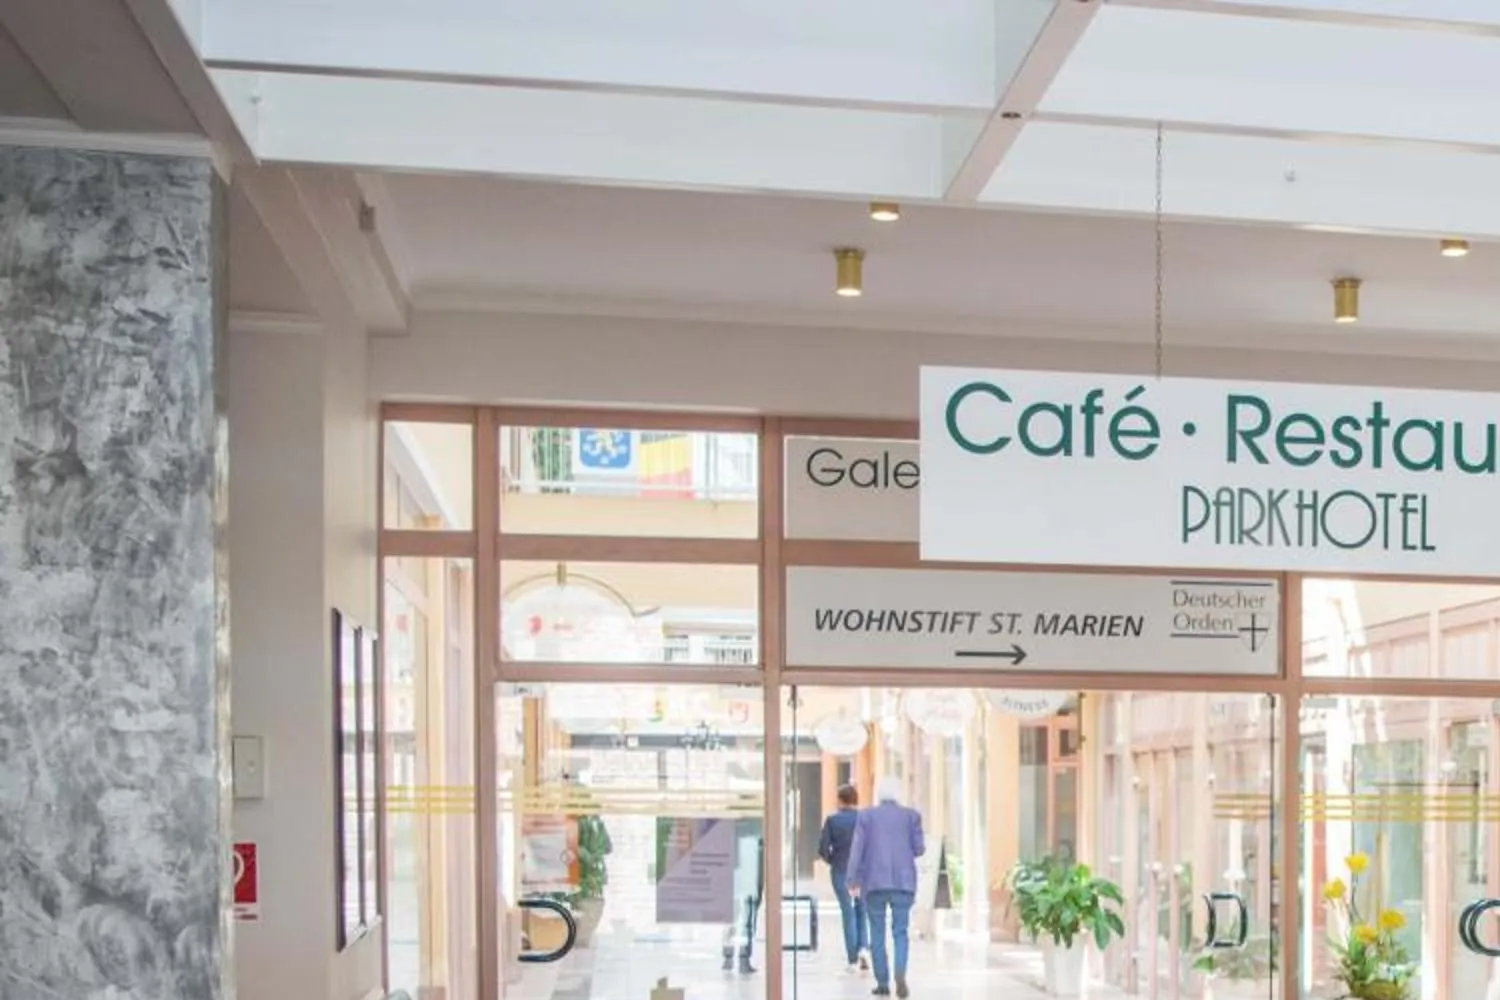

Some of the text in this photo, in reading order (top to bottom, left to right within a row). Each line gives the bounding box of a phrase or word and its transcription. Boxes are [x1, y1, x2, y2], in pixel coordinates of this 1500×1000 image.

[945, 380, 1161, 461] Café
[1182, 485, 1436, 554] PARKHOTEL
[1171, 588, 1268, 611] Deutscher
[814, 607, 1145, 638] WOHNSTIFT ST. MARIEN
[1172, 613, 1234, 633] Orden
